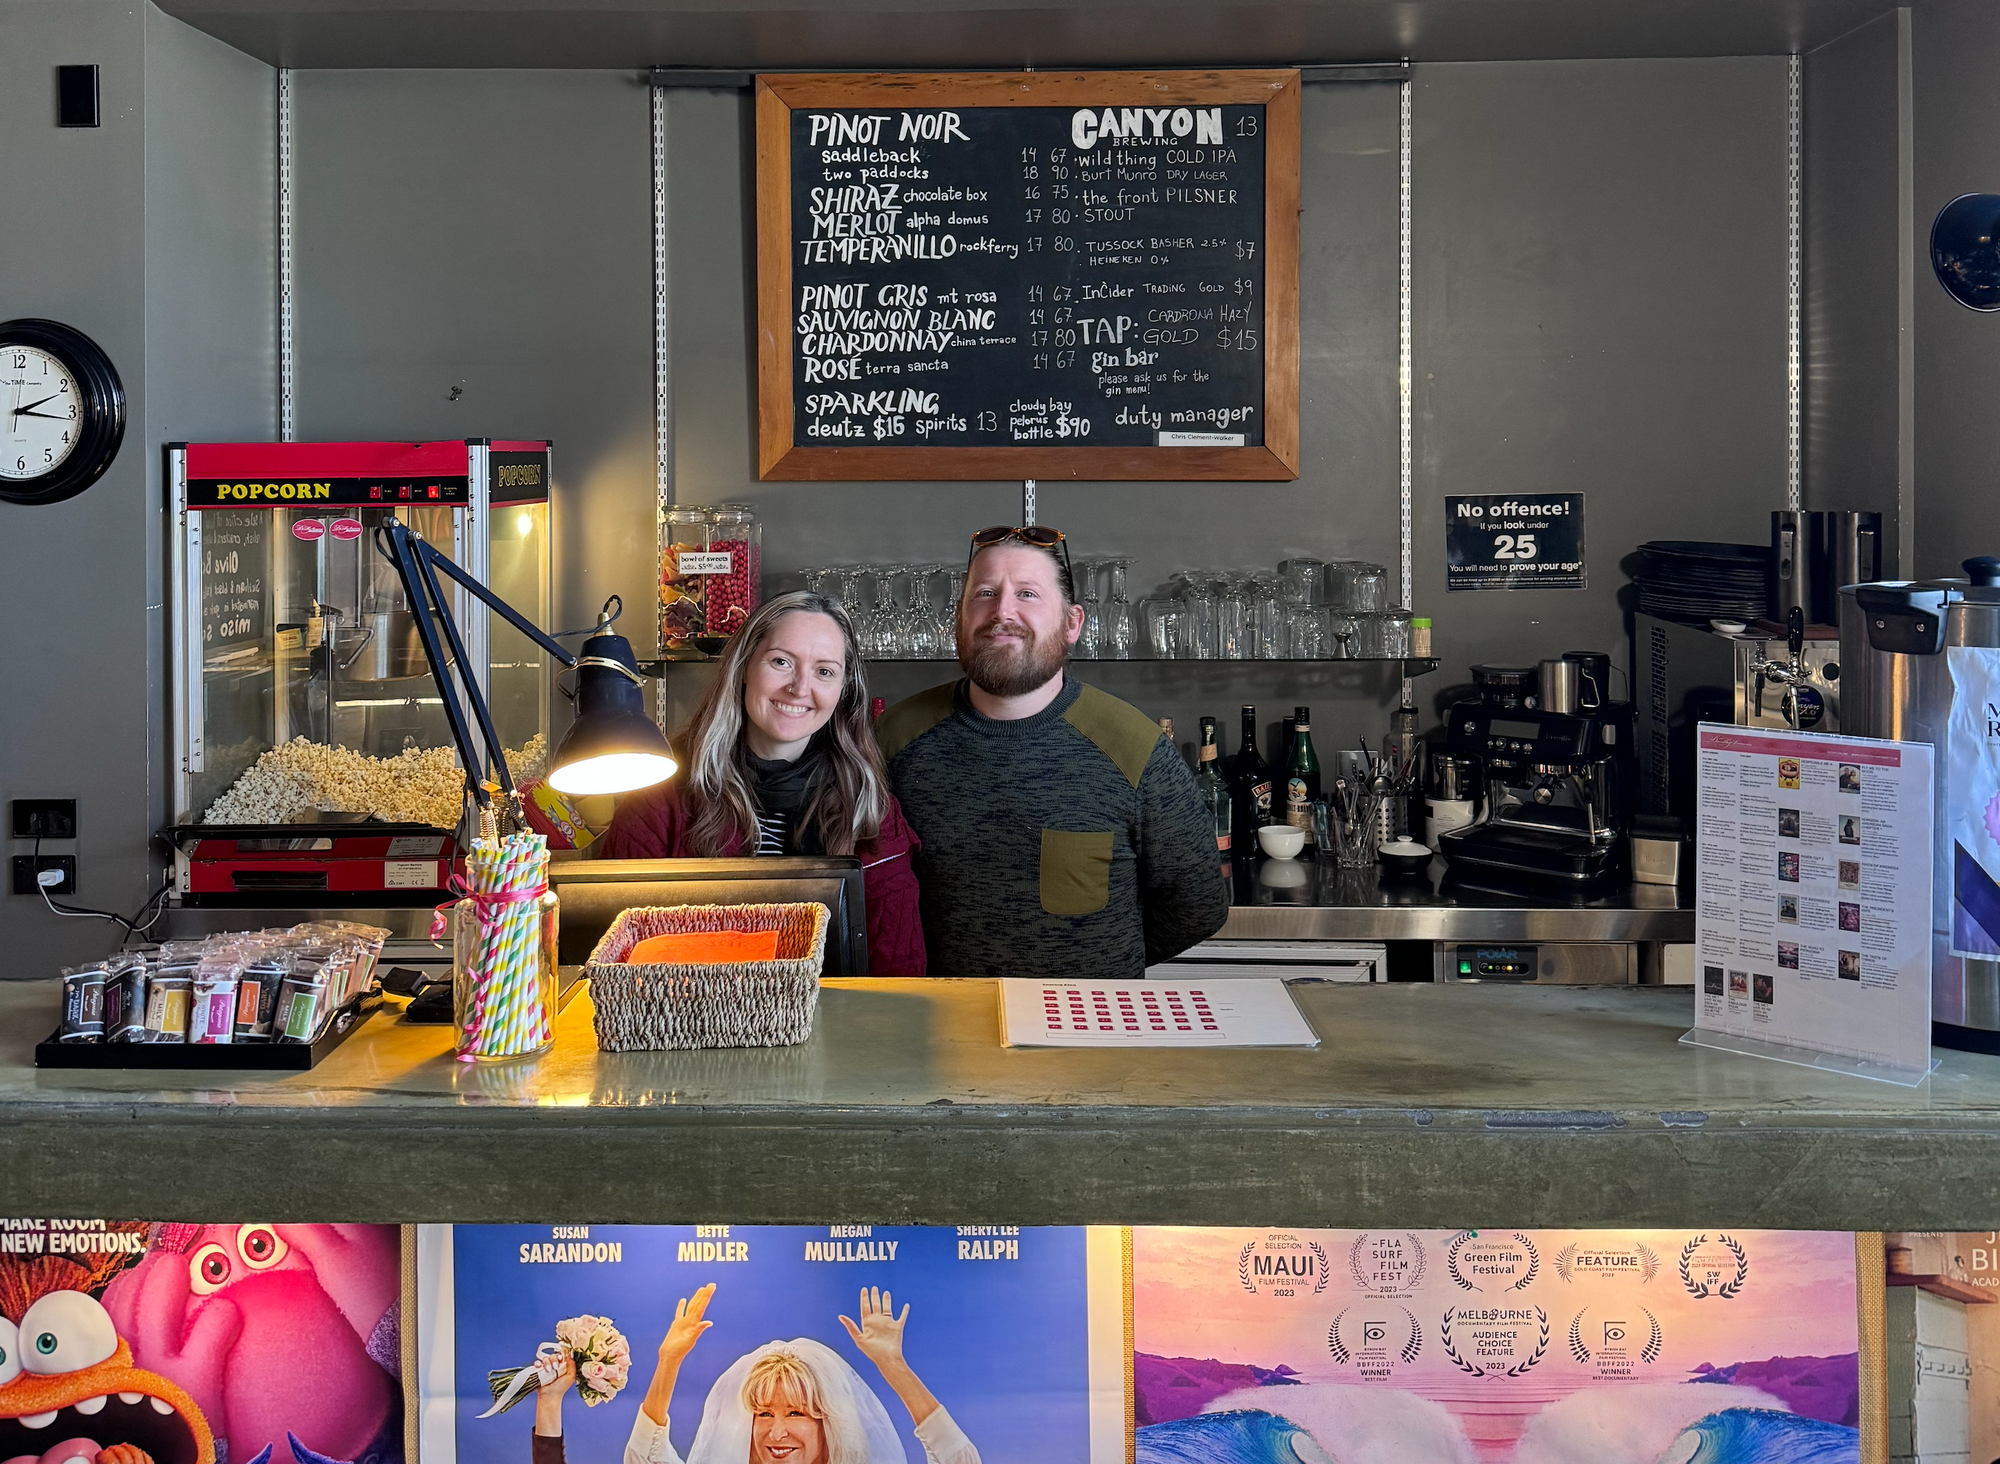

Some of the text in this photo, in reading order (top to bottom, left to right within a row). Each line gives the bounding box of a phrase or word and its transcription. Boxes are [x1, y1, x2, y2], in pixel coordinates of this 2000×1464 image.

[808, 112, 971, 146] PINOT NOIR
[1072, 107, 1258, 149] CANYON 13
[1113, 137, 1179, 146] BREWING
[822, 147, 1066, 164] saddleback 14 67
[1079, 150, 1237, 170] wild thing COLD IPA
[822, 164, 1069, 184] two paddocks 18 90
[1082, 168, 1228, 181] Burt Munro DRY LAGER
[809, 183, 1069, 214] SHIRAZ chocolate box 16 75
[1083, 188, 1238, 204] the front PILSNER
[812, 208, 1071, 239] MERLOT alpha domus 17 80
[1084, 208, 1135, 222] STOUT
[800, 234, 1073, 265] TEMPERANILLO rockferry 17 80
[1086, 238, 1255, 261] TUSSOCK BASHER $7
[1199, 282, 1225, 292] GOLD
[1234, 278, 1253, 296] $9
[800, 283, 1072, 312] PINOT GRIS mt rosa 14 67
[797, 307, 1073, 334] SAUVIGNON BLANC 14 67
[1148, 301, 1252, 323] CARDRONA HAZY
[801, 328, 1076, 355] CHARDONNAY china terrace 17 80
[1077, 316, 1257, 350] TAP: GOLD $15
[13, 355, 26, 369] 12
[42, 361, 48, 375] 1
[802, 350, 1075, 384] ROSÉ terra sancta 14 67
[1092, 347, 1159, 373] gin bar
[60, 378, 68, 393] 2
[1098, 369, 1210, 389] please ask us for the
[1105, 383, 1151, 398] gin menu!
[804, 387, 1072, 416] SPARKLING cloudy bay
[807, 411, 1091, 440] deutz $15 spirits 13 pelorus $90
[1115, 404, 1253, 430] duty manager
[61, 430, 70, 444] 4
[1014, 424, 1054, 440] bottle
[17, 455, 25, 470] 6
[44, 448, 53, 463] 5
[217, 463, 541, 500] POPCORN POPCORN
[1457, 501, 1570, 517] No offence!
[1487, 523, 1502, 531] you
[1504, 521, 1525, 529] look
[1494, 534, 1537, 559] 25
[1509, 564, 1536, 572] prove
[1538, 563, 1560, 572] your
[553, 1225, 872, 1239] SUSAN BETTE MEGAN
[1, 1233, 146, 1253] NEW EMOTIONS.
[520, 1240, 1019, 1263] SARANDON MIDLER MULLALLY RALPH
[1373, 1250, 1403, 1259] SURF
[1464, 1252, 1522, 1262] Green Film
[1577, 1257, 1638, 1266] FEATURE
[1254, 1256, 1313, 1276] MAUI
[1381, 1261, 1408, 1270] FILM
[1473, 1265, 1515, 1274] Festival
[1373, 1272, 1402, 1280] FEST
